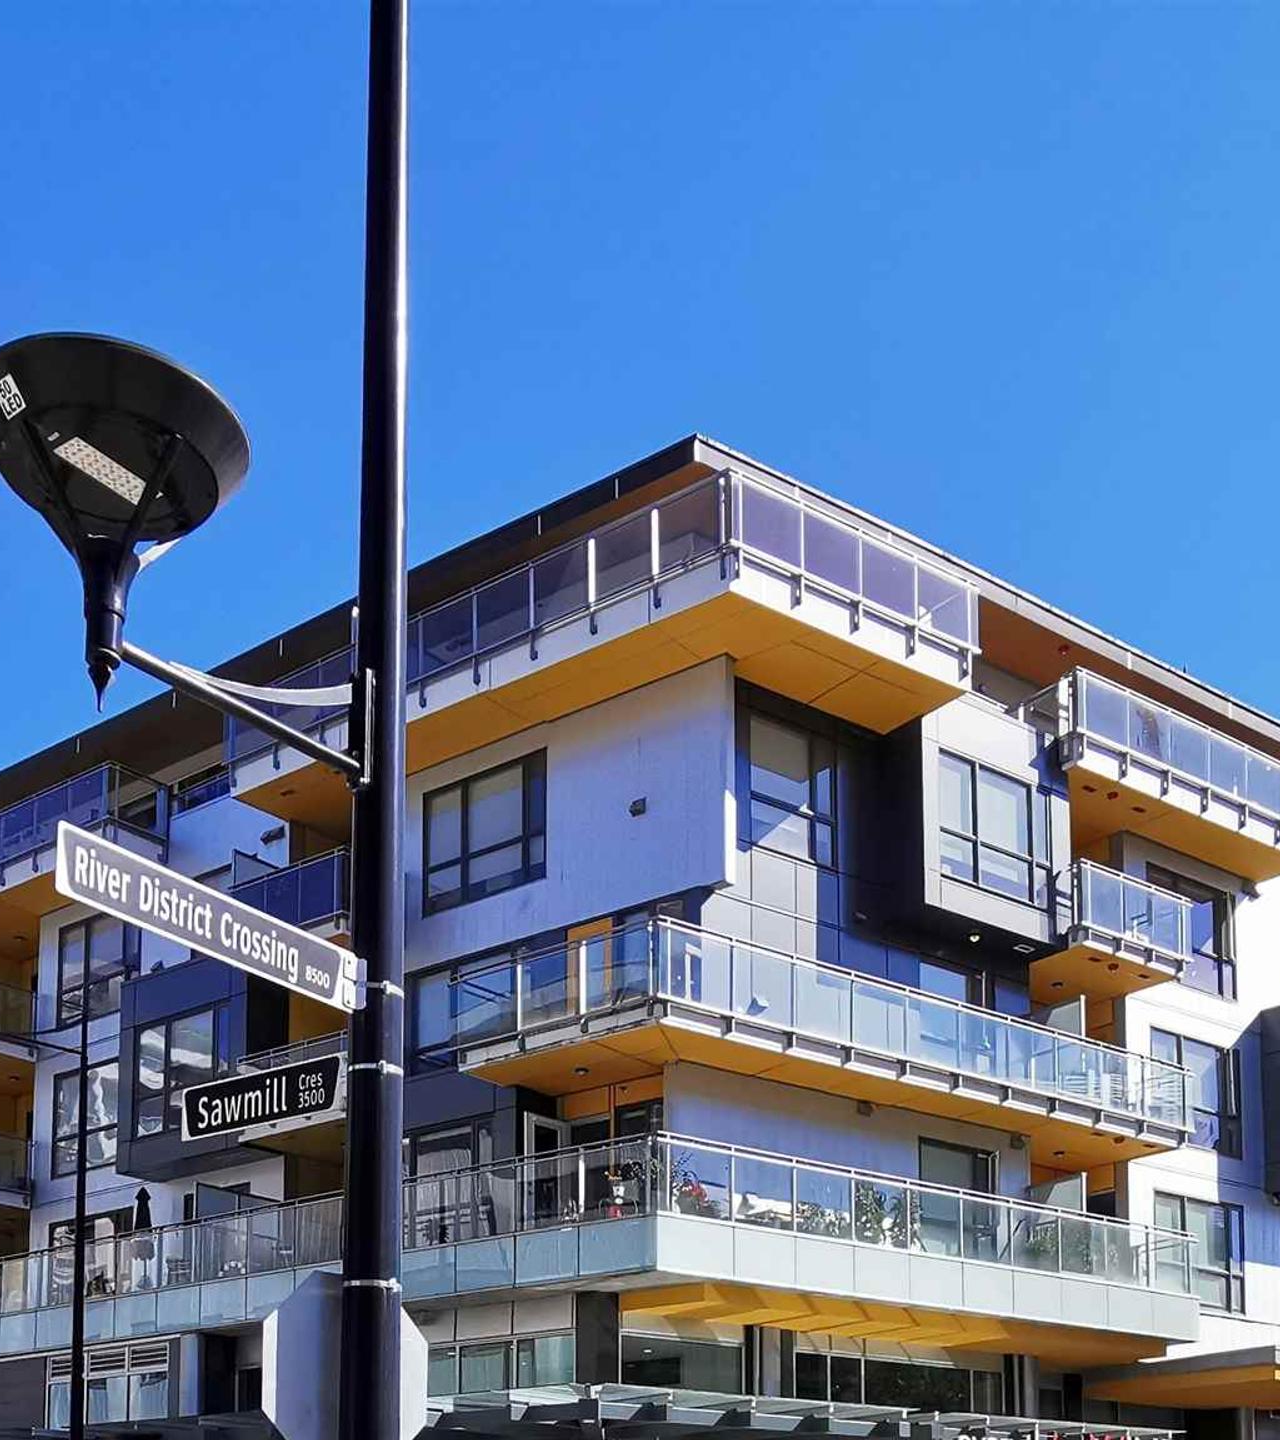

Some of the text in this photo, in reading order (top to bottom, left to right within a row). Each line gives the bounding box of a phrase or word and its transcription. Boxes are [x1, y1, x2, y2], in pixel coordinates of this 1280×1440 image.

[2, 392, 23, 417] LED
[74, 845, 330, 989] River District Crossing 8500
[298, 1072, 323, 1090] Cres
[197, 1075, 287, 1129] Sawmill
[298, 1087, 325, 1110] 3500
